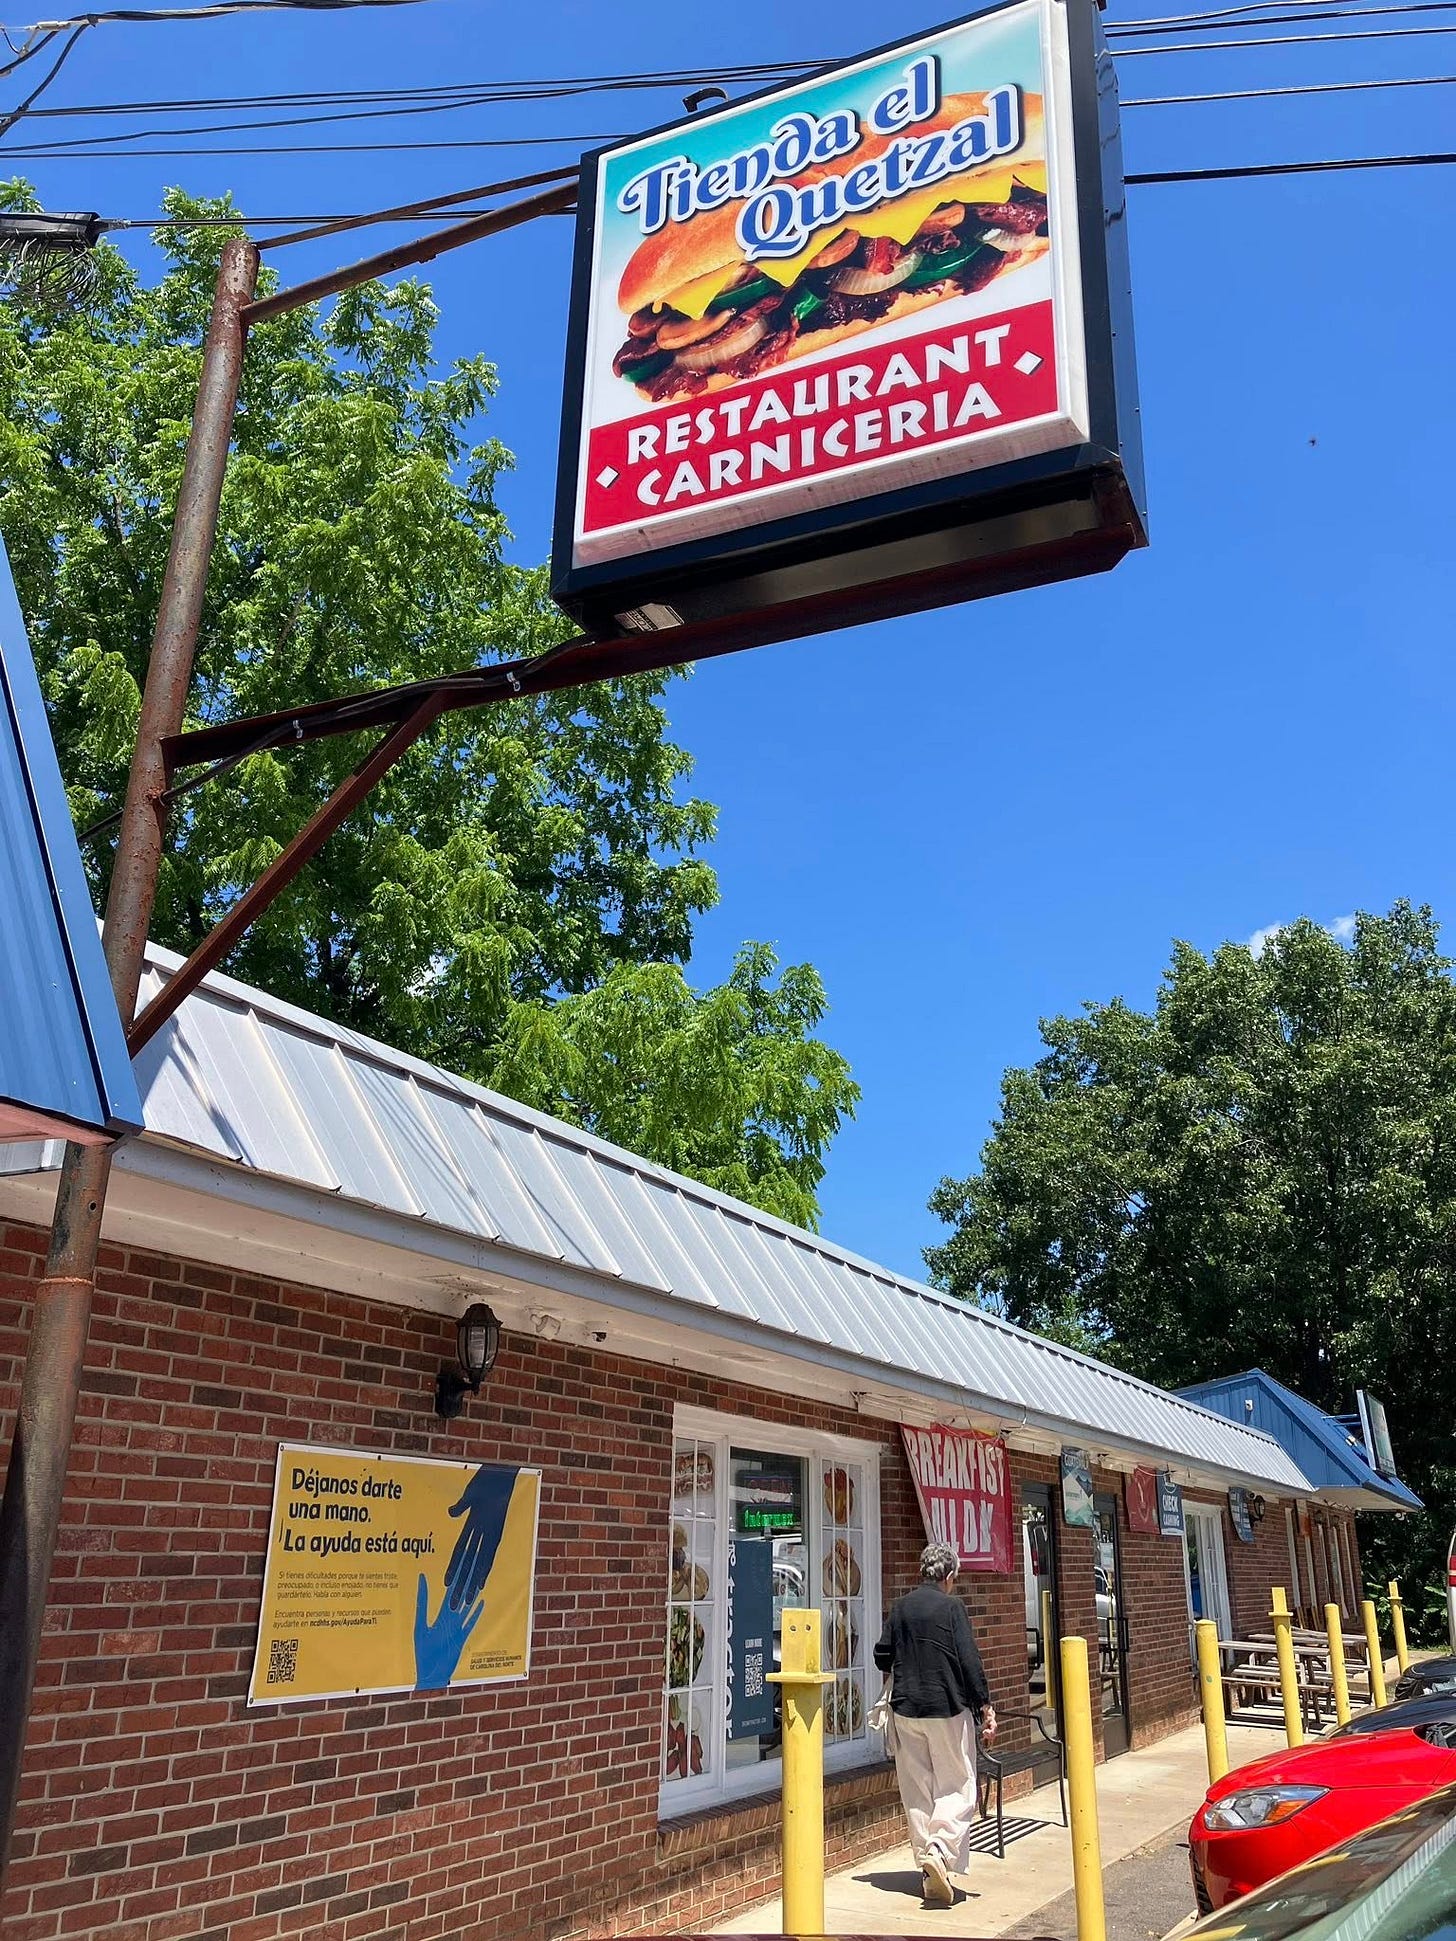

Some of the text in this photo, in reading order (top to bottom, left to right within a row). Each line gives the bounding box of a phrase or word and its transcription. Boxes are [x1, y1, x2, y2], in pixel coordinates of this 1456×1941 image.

[620, 57, 935, 231] Tienda el
[738, 86, 1022, 257] Quetzal
[627, 324, 1011, 464] RESTAURANT
[637, 383, 1002, 506] CARNICERIA
[288, 1503, 372, 1523] una mano.
[292, 1468, 402, 1500] Déjanos darte
[1162, 1494, 1178, 1512] CHECK
[283, 1528, 435, 1558] La ayuda está aquí.
